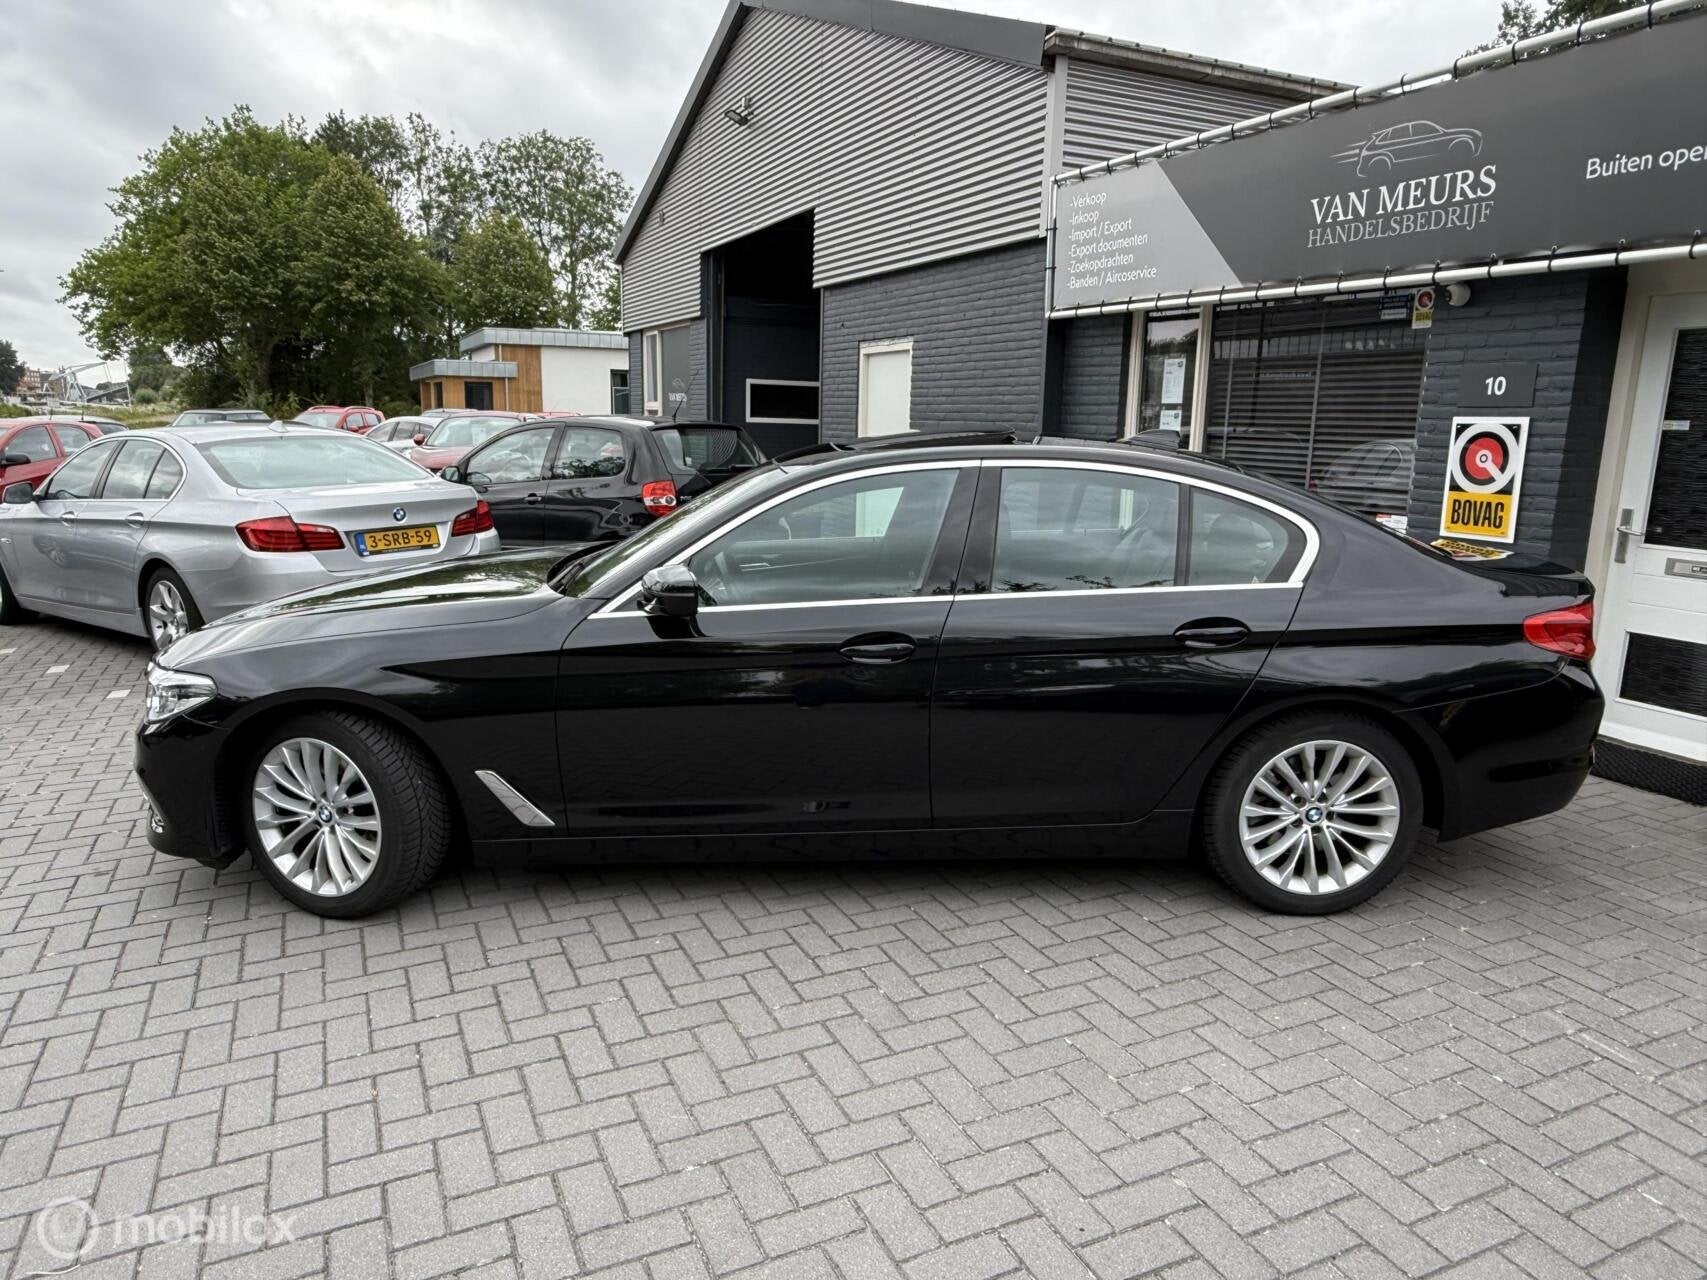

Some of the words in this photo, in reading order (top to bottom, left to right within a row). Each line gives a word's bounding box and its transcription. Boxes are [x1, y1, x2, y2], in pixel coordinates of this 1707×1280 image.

[1586, 153, 1653, 179] Buiten
[1310, 189, 1370, 225] VAN
[1376, 164, 1497, 215] MEURS
[1104, 218, 1132, 236] Export
[1307, 201, 1494, 247] HANDELSBEDRIJF
[1098, 233, 1148, 253] documenten
[1105, 265, 1157, 284] Aircoservice
[1485, 376, 1507, 396] 10
[1451, 498, 1505, 529] BOVAG
[368, 529, 432, 549] 3-SRB-59
